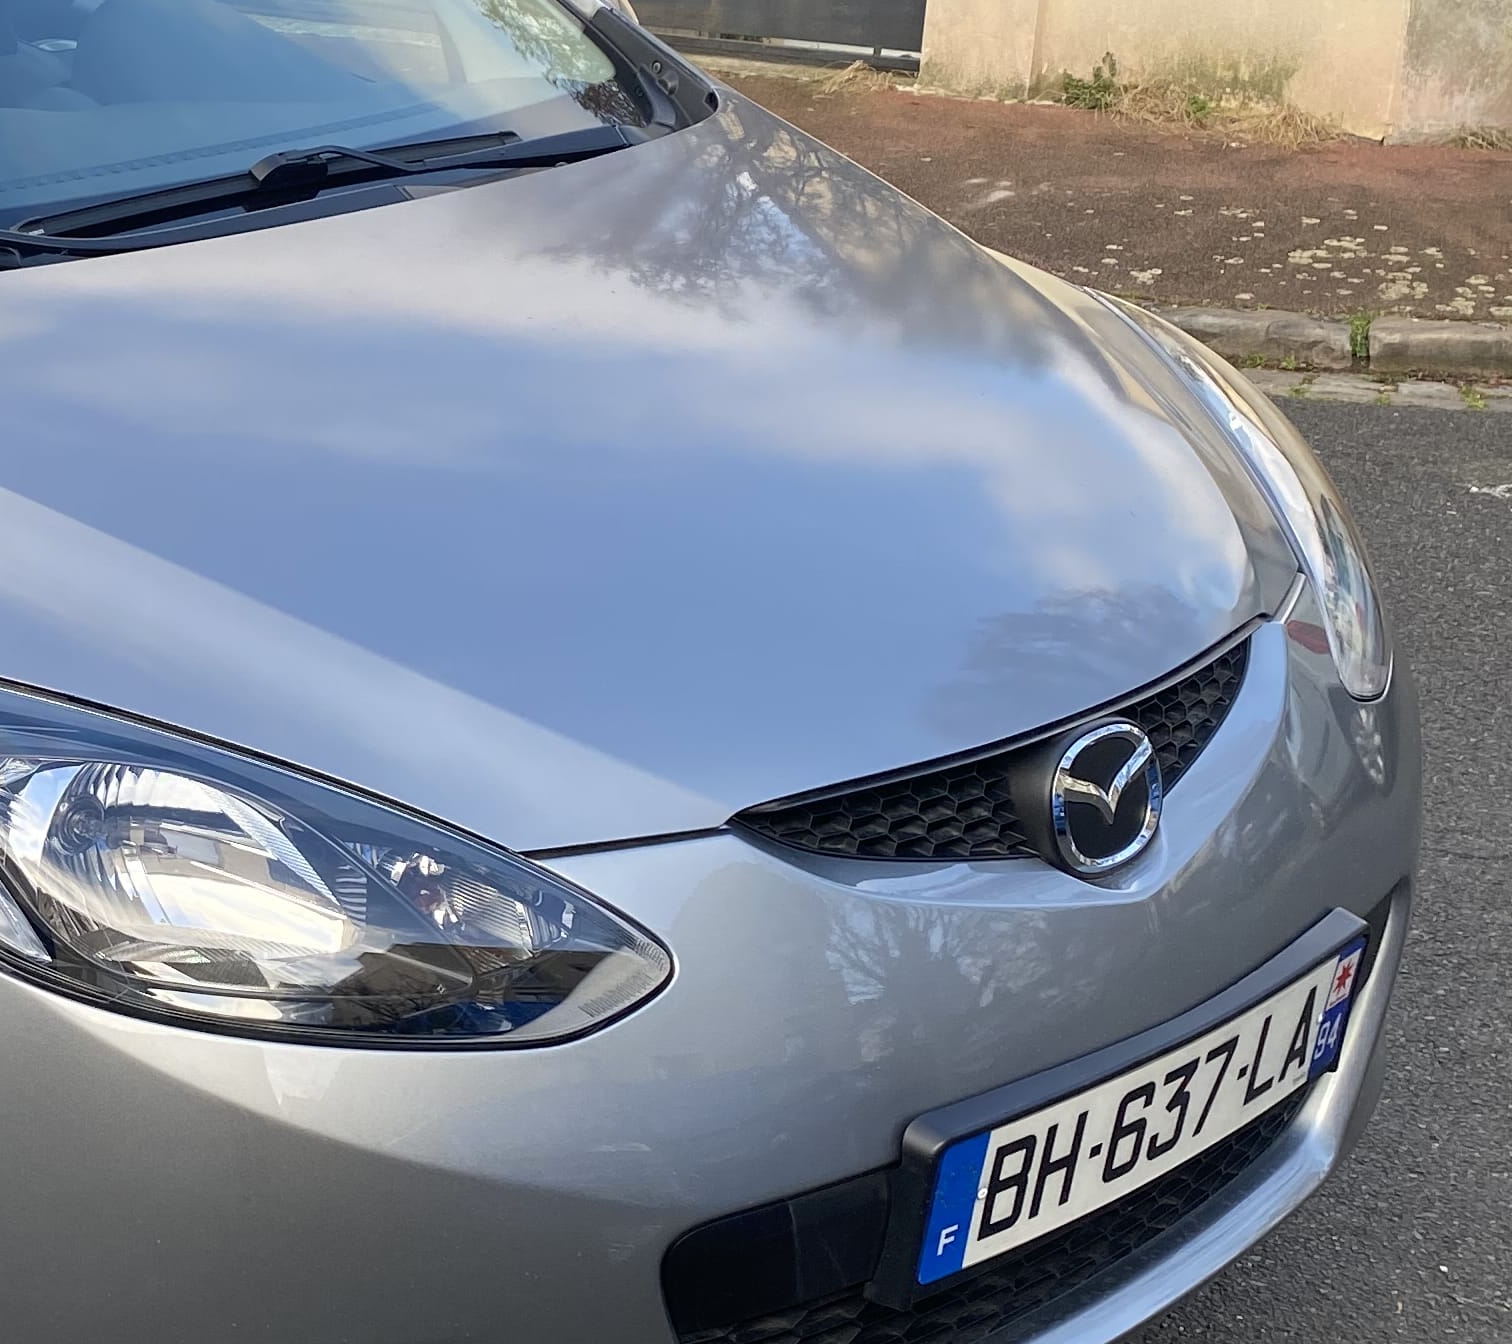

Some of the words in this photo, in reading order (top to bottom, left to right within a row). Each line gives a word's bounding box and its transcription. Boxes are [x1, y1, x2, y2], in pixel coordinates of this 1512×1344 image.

[1314, 1012, 1343, 1061] 94
[977, 985, 1318, 1242] BH-637-LA
[936, 1224, 959, 1257] F
